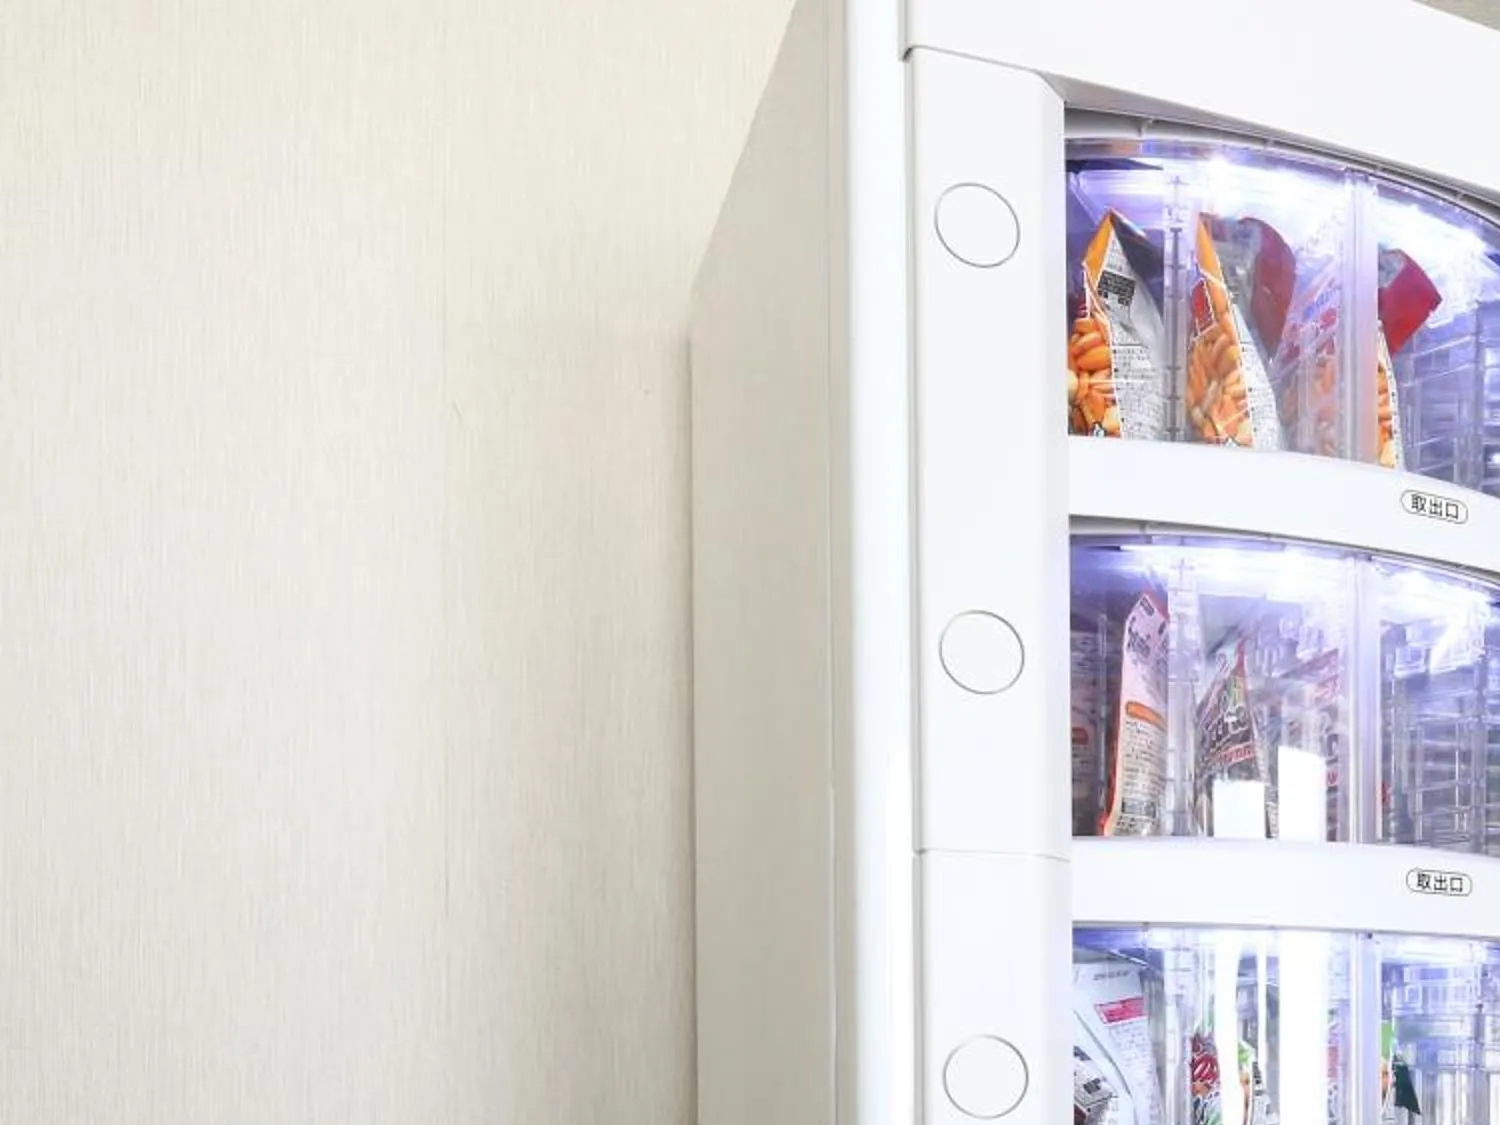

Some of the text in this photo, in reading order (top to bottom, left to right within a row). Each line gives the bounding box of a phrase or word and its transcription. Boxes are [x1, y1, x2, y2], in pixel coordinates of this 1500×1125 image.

[1411, 496, 1459, 519] 取出口
[1416, 870, 1464, 893] 取出口
